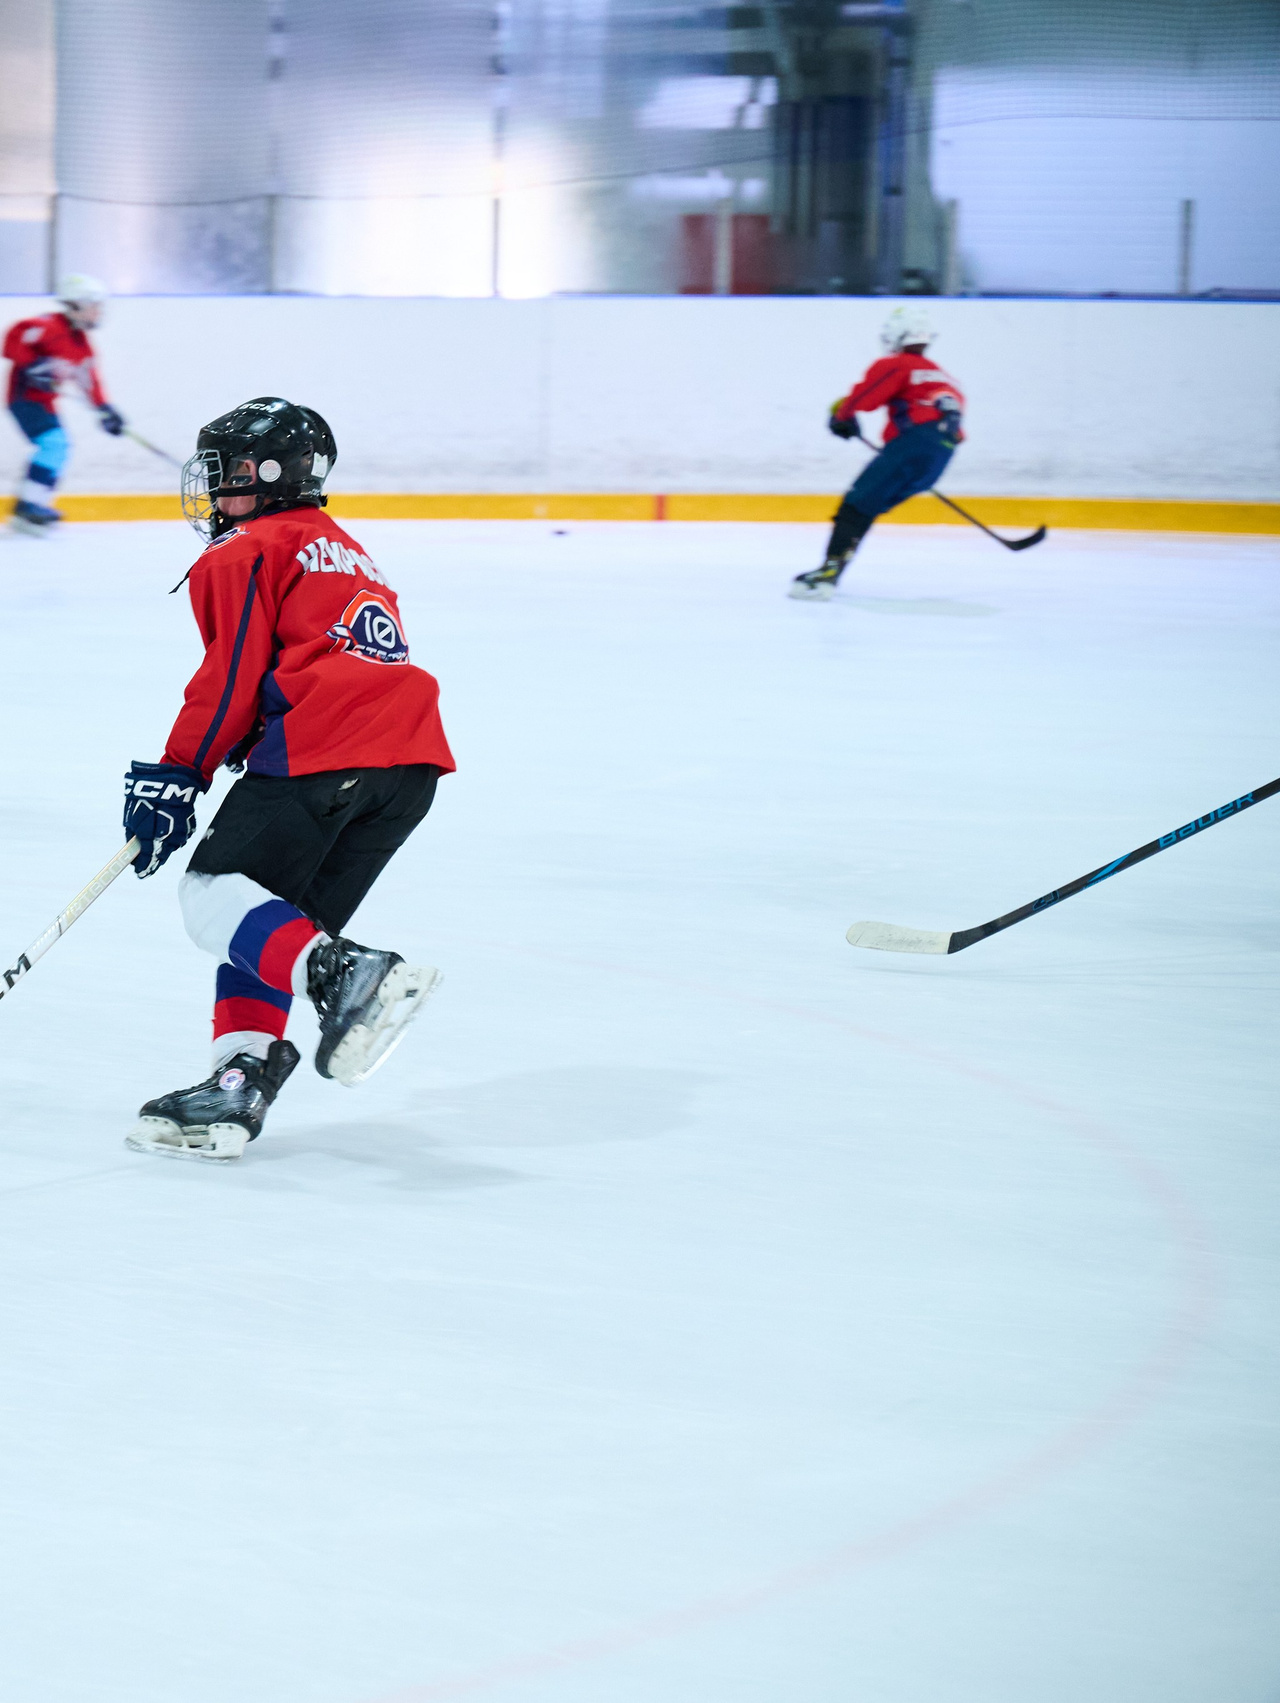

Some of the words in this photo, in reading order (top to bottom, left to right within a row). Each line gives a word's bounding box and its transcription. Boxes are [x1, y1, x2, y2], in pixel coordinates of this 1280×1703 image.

[363, 610, 396, 649] 10
[124, 777, 195, 803] CCM
[1158, 792, 1254, 848] BAUER
